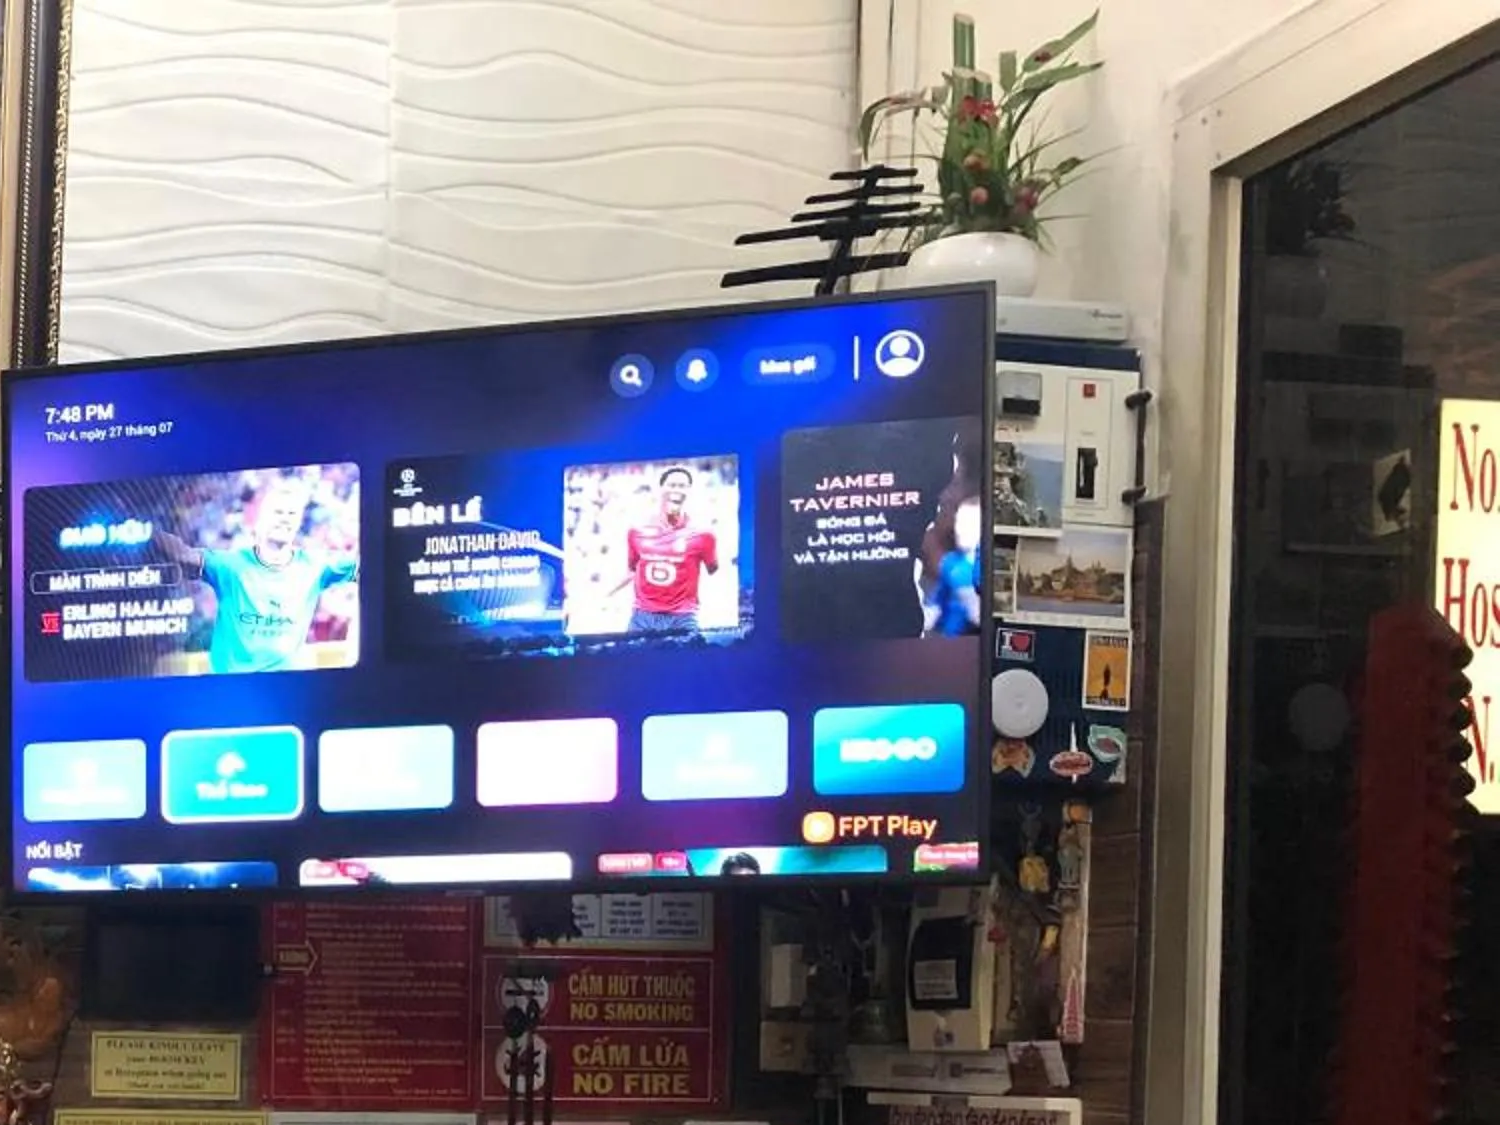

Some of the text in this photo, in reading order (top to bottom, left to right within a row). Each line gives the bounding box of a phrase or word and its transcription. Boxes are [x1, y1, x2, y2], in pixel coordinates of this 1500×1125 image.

[45, 403, 114, 424] 7:48 PM
[80, 427, 106, 443] ngày
[109, 425, 123, 438] 27
[125, 424, 157, 437] tháng
[158, 421, 174, 433] 07
[1450, 421, 1500, 513] No
[815, 472, 894, 491] JAMES
[789, 491, 920, 512] TAVERNIER
[424, 533, 496, 555] JONATHAN
[63, 597, 194, 621] ERLING HAALAND
[63, 617, 187, 640] BAYERN MUNICH
[838, 814, 937, 840] FPT Play
[570, 1002, 694, 1021] NO SMOKING
[572, 1036, 689, 1067] CẤM LỬA
[573, 1072, 690, 1095] NO FIRE
